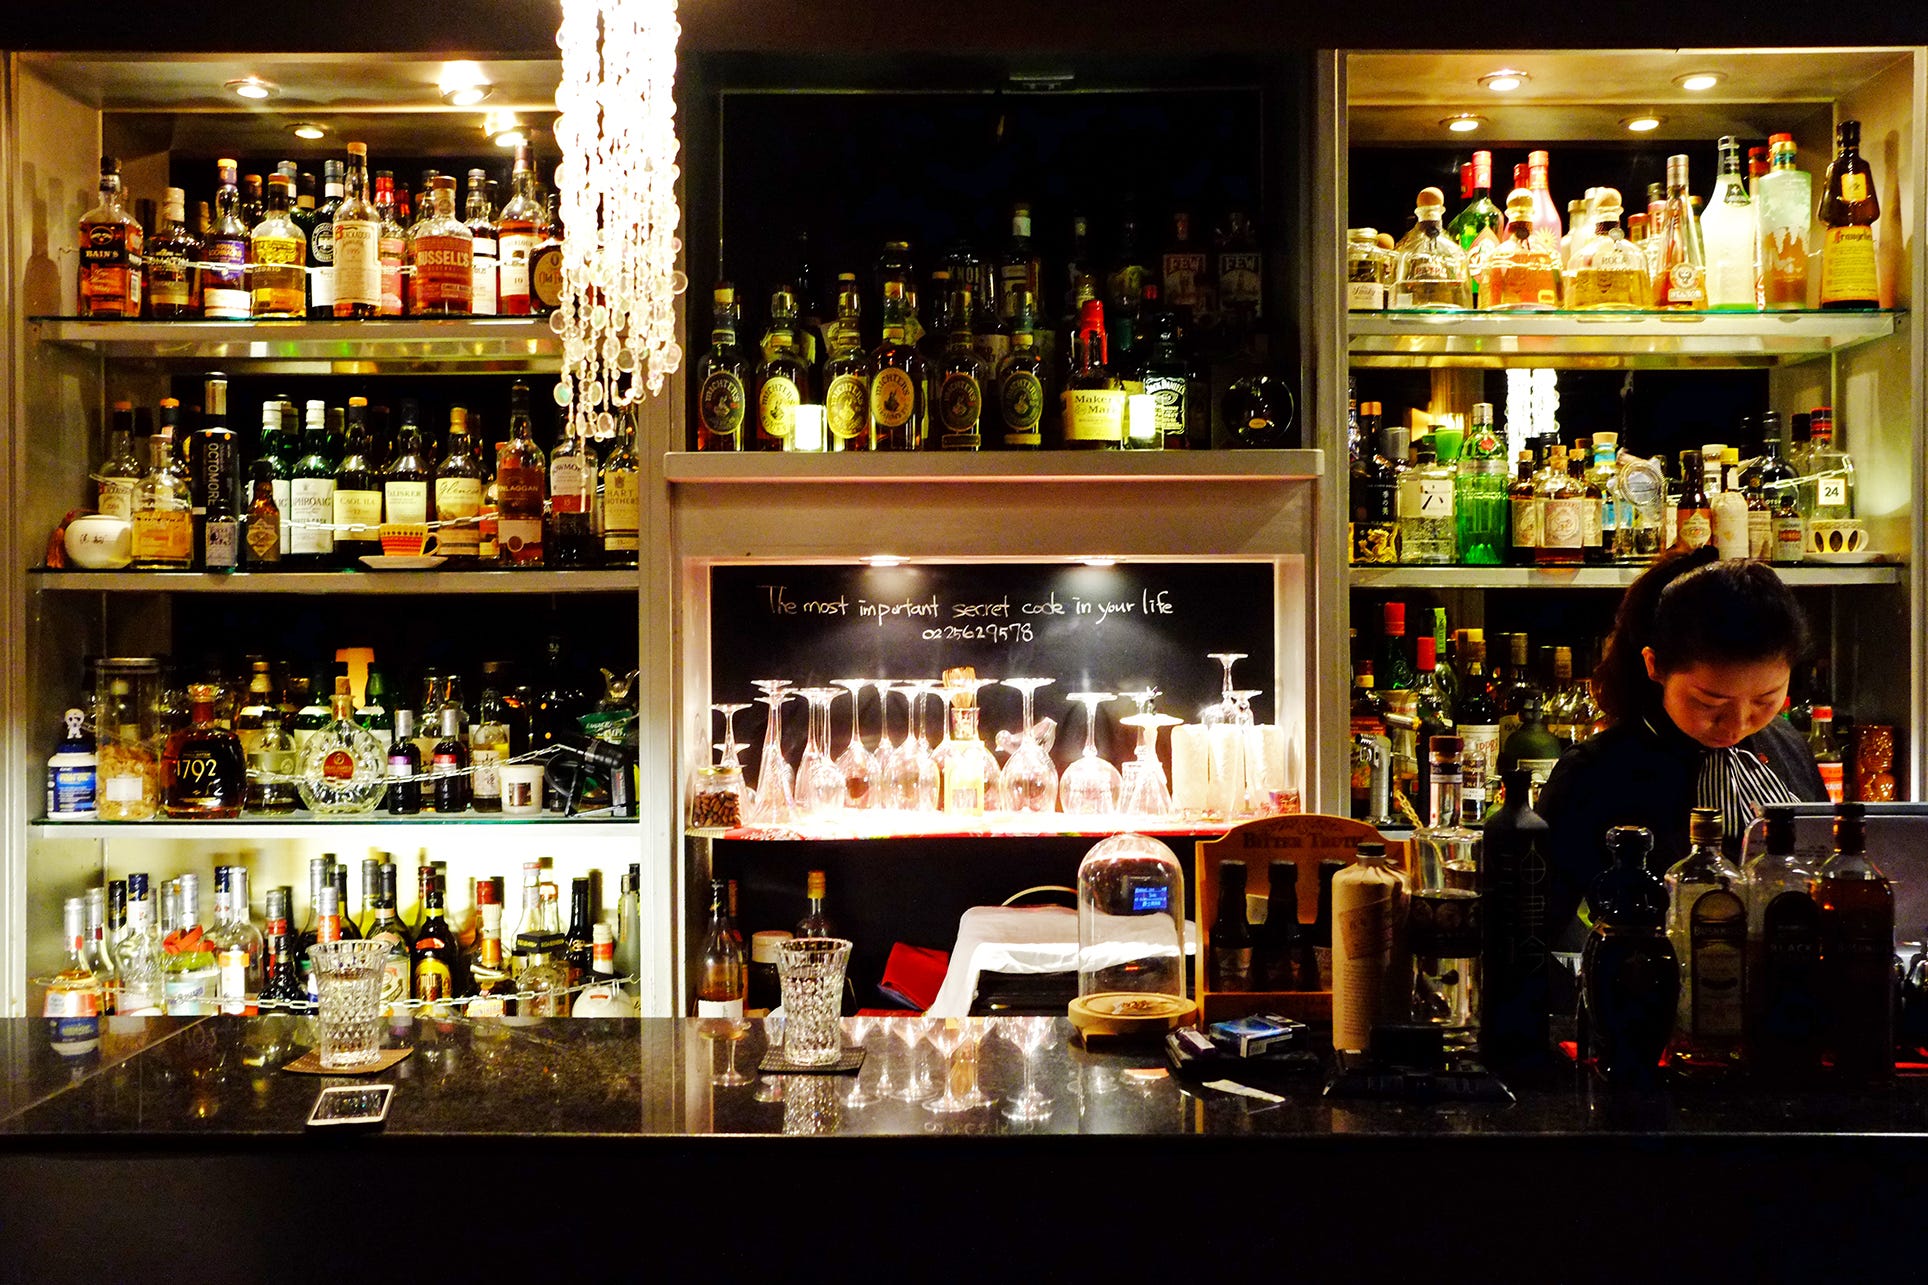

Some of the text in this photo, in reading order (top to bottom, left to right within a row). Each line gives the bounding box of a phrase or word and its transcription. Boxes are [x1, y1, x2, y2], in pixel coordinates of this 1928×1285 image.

[85, 250, 119, 258] BAIN'S
[417, 250, 470, 267] RUSSELL'S
[208, 442, 219, 507] OCTOMORE
[1824, 486, 1839, 497] 24
[756, 585, 1174, 626] The most important secret code in your life
[921, 623, 1034, 644] 0225629578
[176, 758, 218, 783] 1792
